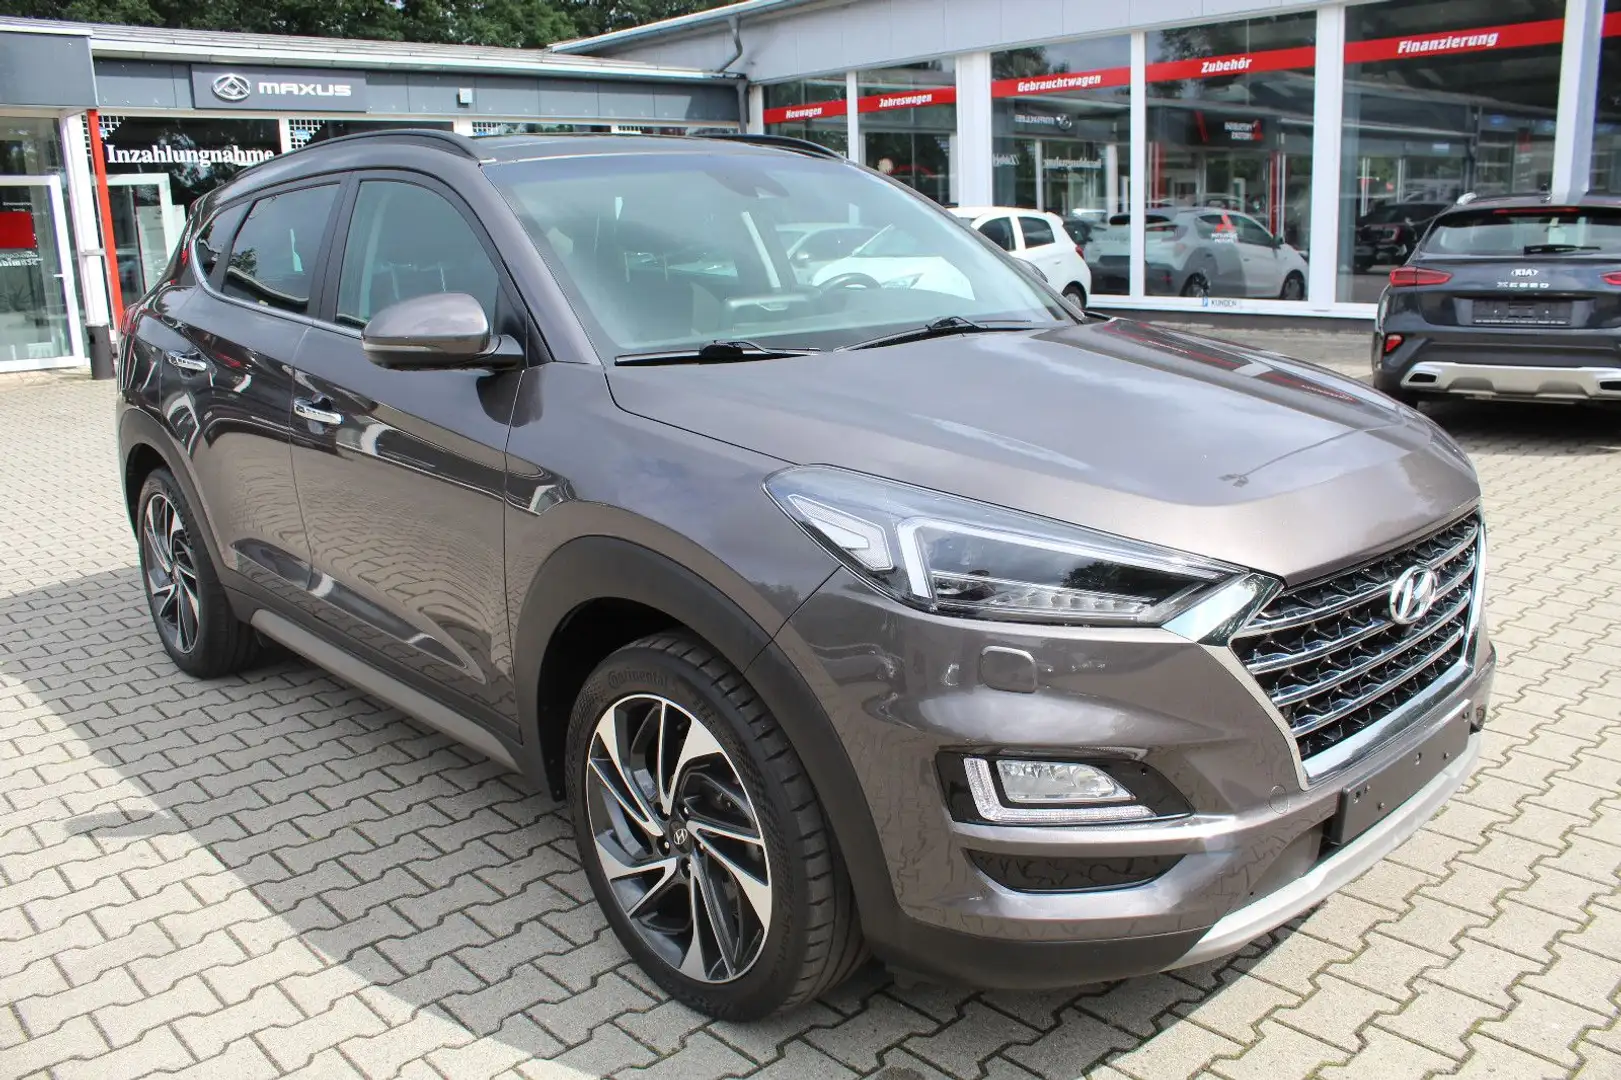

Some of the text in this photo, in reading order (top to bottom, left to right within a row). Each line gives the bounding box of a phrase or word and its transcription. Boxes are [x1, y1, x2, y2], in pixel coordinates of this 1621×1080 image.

[1397, 31, 1499, 54] Finanzierung
[1200, 56, 1252, 74] Zubehör
[258, 81, 352, 97] MAXUS
[1017, 73, 1102, 93] Gebrauchtwagen
[878, 93, 933, 108] Jahreswagen
[785, 106, 822, 119] Neuwagen
[106, 144, 275, 167] Inzahlungnahme
[1514, 268, 1533, 276] KIA
[608, 667, 668, 689] Continental
